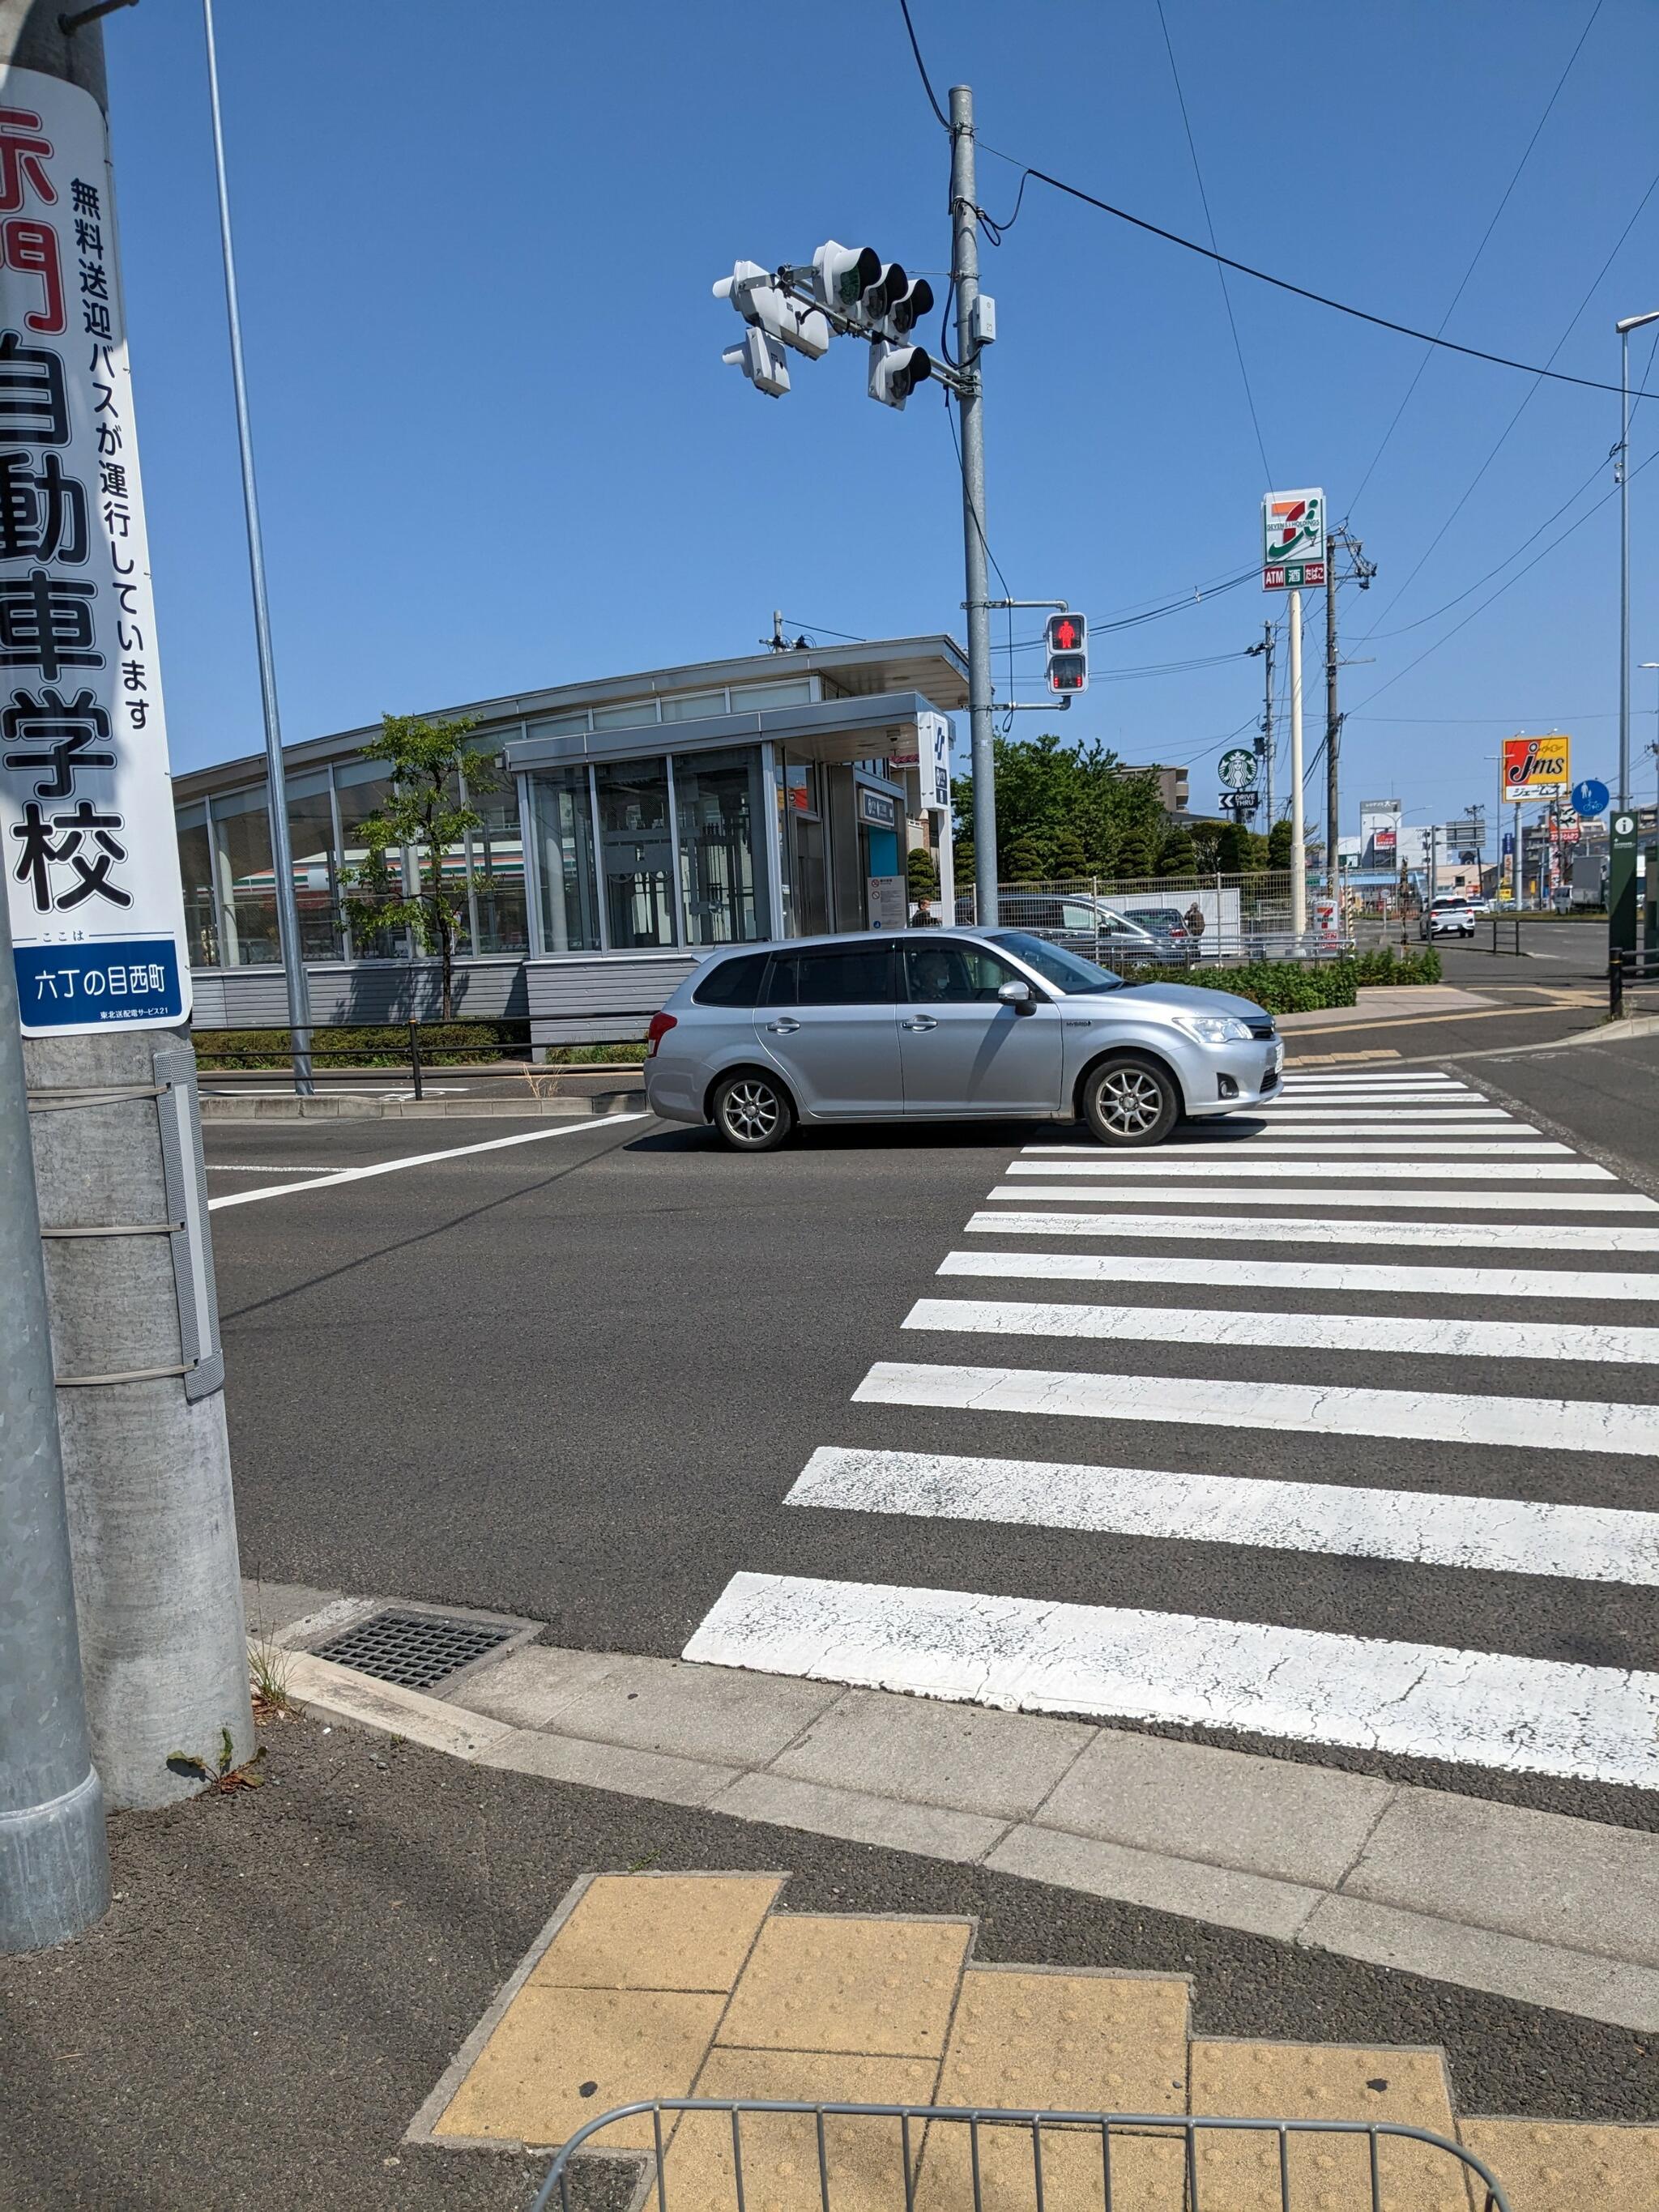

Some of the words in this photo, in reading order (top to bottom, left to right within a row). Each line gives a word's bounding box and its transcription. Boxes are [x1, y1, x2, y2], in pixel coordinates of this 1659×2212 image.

[70, 177, 150, 730] 無料送迎バスが運行しています
[1265, 571, 1283, 585] ATM
[1288, 569, 1301, 583] 酒
[1305, 567, 1324, 581] たばこ
[42, 930, 85, 942] ここは
[34, 963, 165, 1000] 六丁の目西町
[99, 1007, 169, 1020] 東北送配電サービス21
